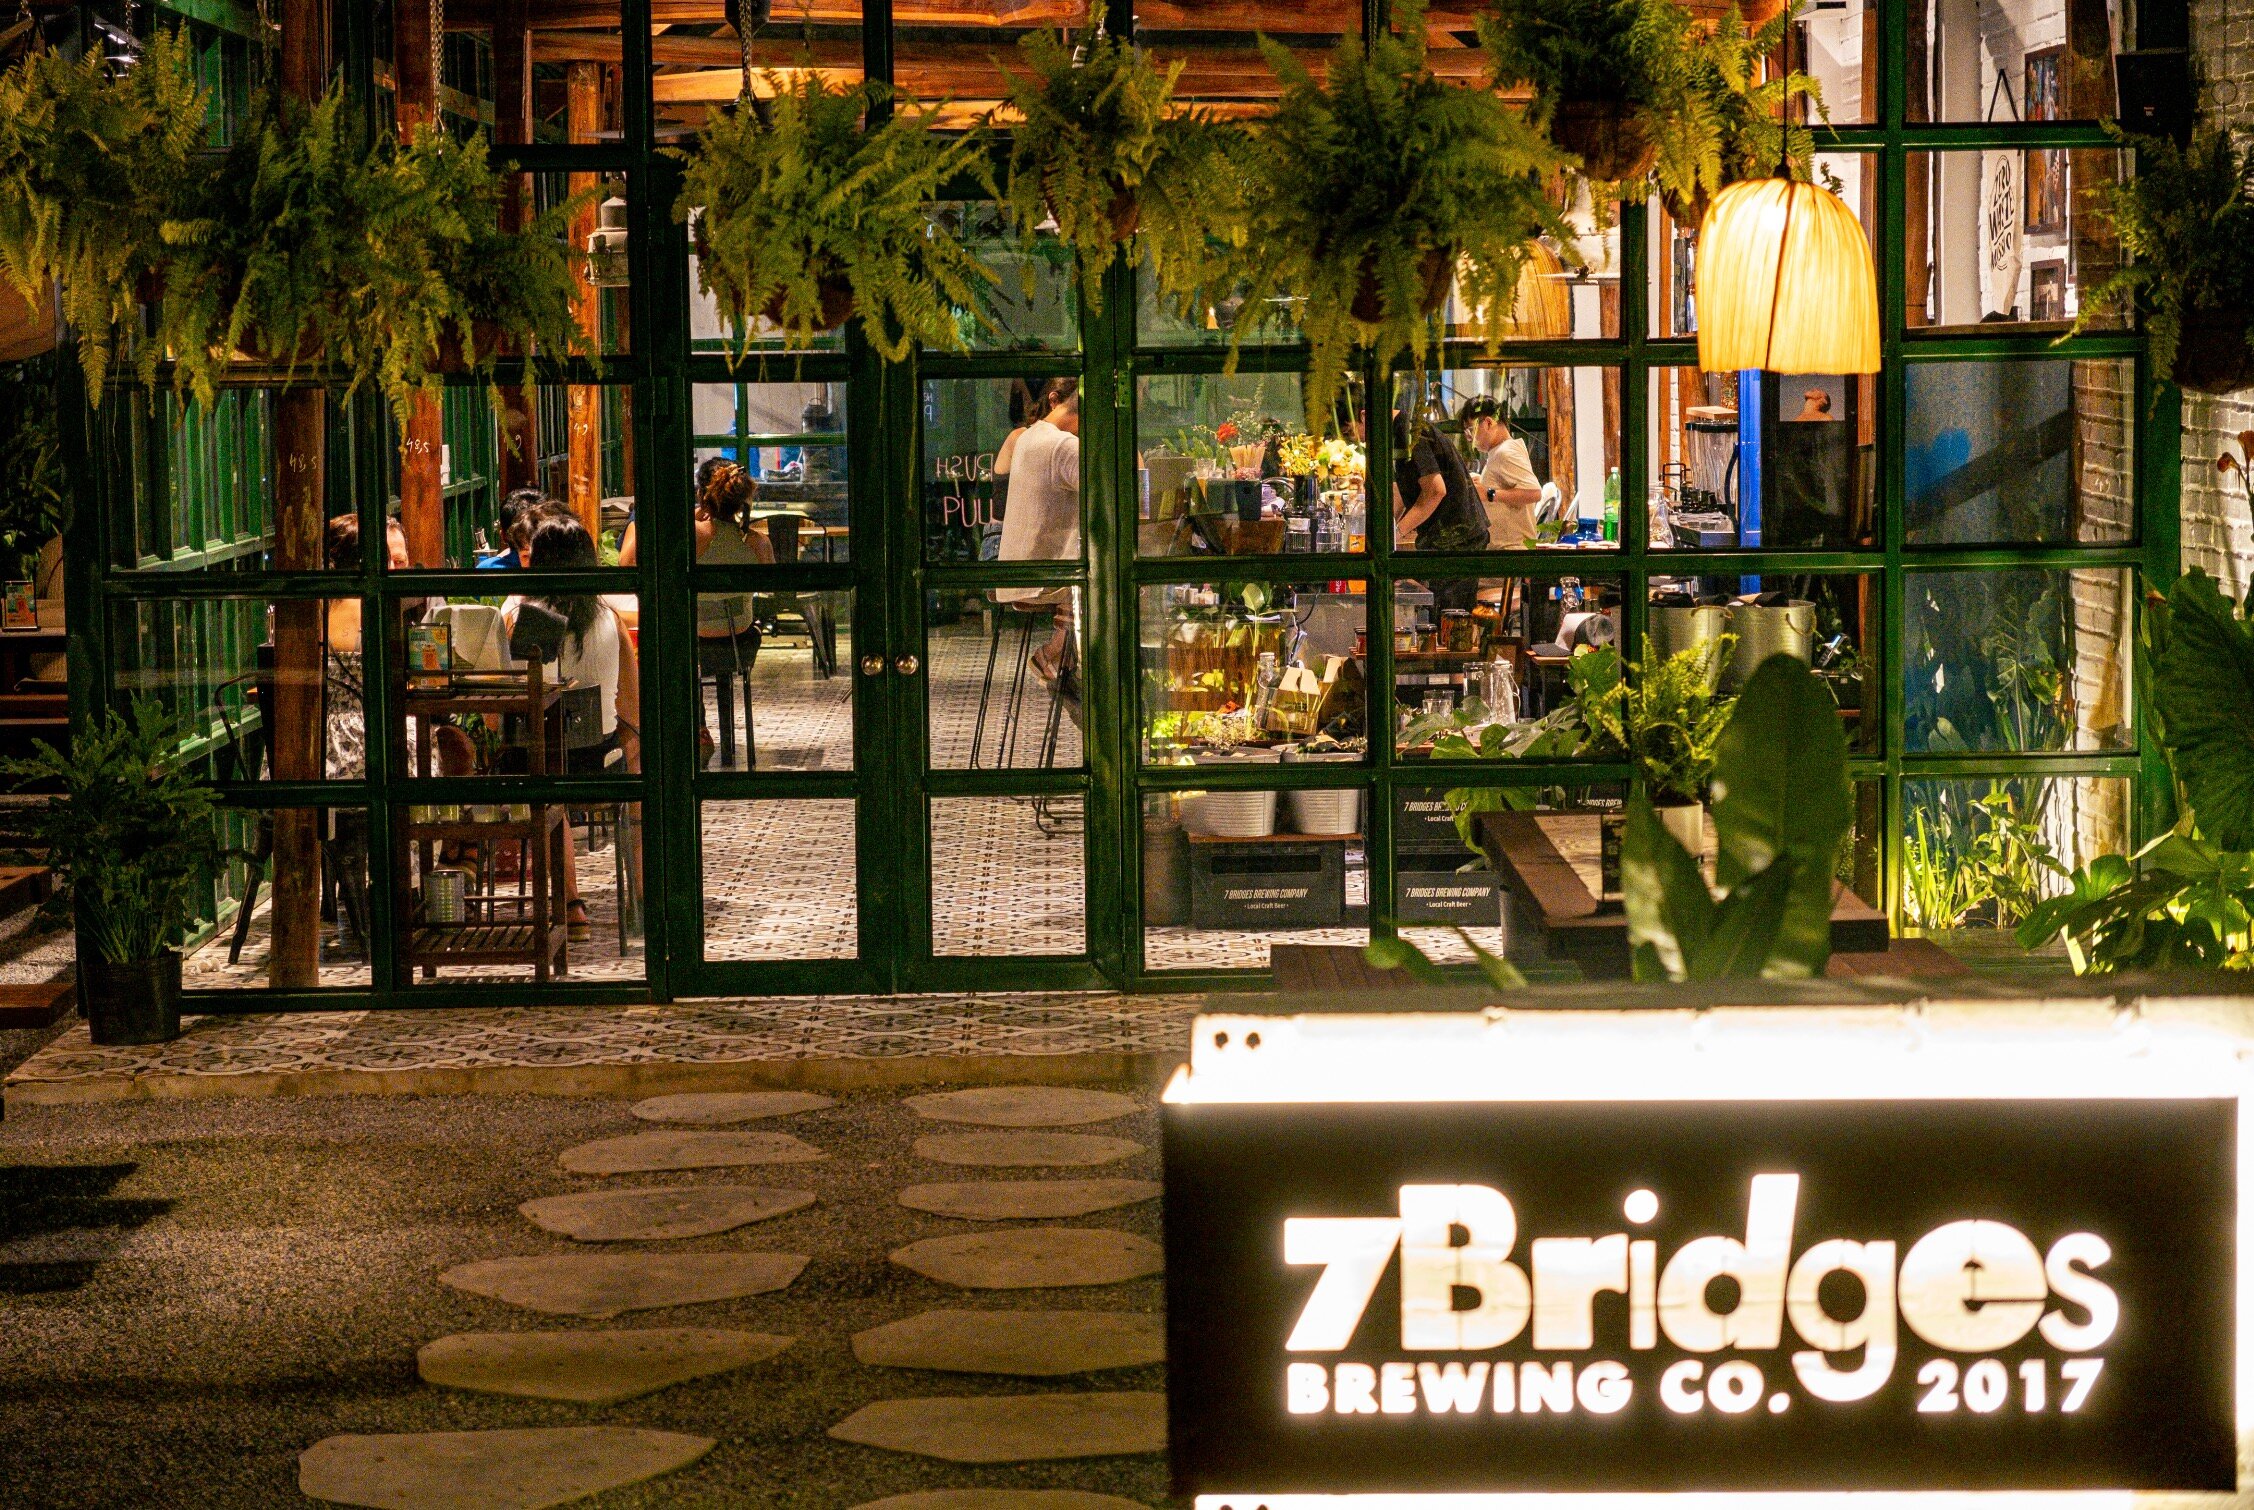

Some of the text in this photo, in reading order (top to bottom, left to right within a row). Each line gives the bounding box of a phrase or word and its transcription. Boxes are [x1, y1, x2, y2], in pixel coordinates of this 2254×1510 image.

[1404, 801, 1409, 811] 7
[1409, 801, 1434, 812] BRIDGES
[1224, 888, 1308, 900] 7 BRIDGES BREWING COMPANY
[1406, 887, 1491, 898] 7 BRIDGES BREWING COMPANY
[1443, 900, 1456, 908] Craft
[1286, 1358, 2105, 1415] BREWING CO. 2017
